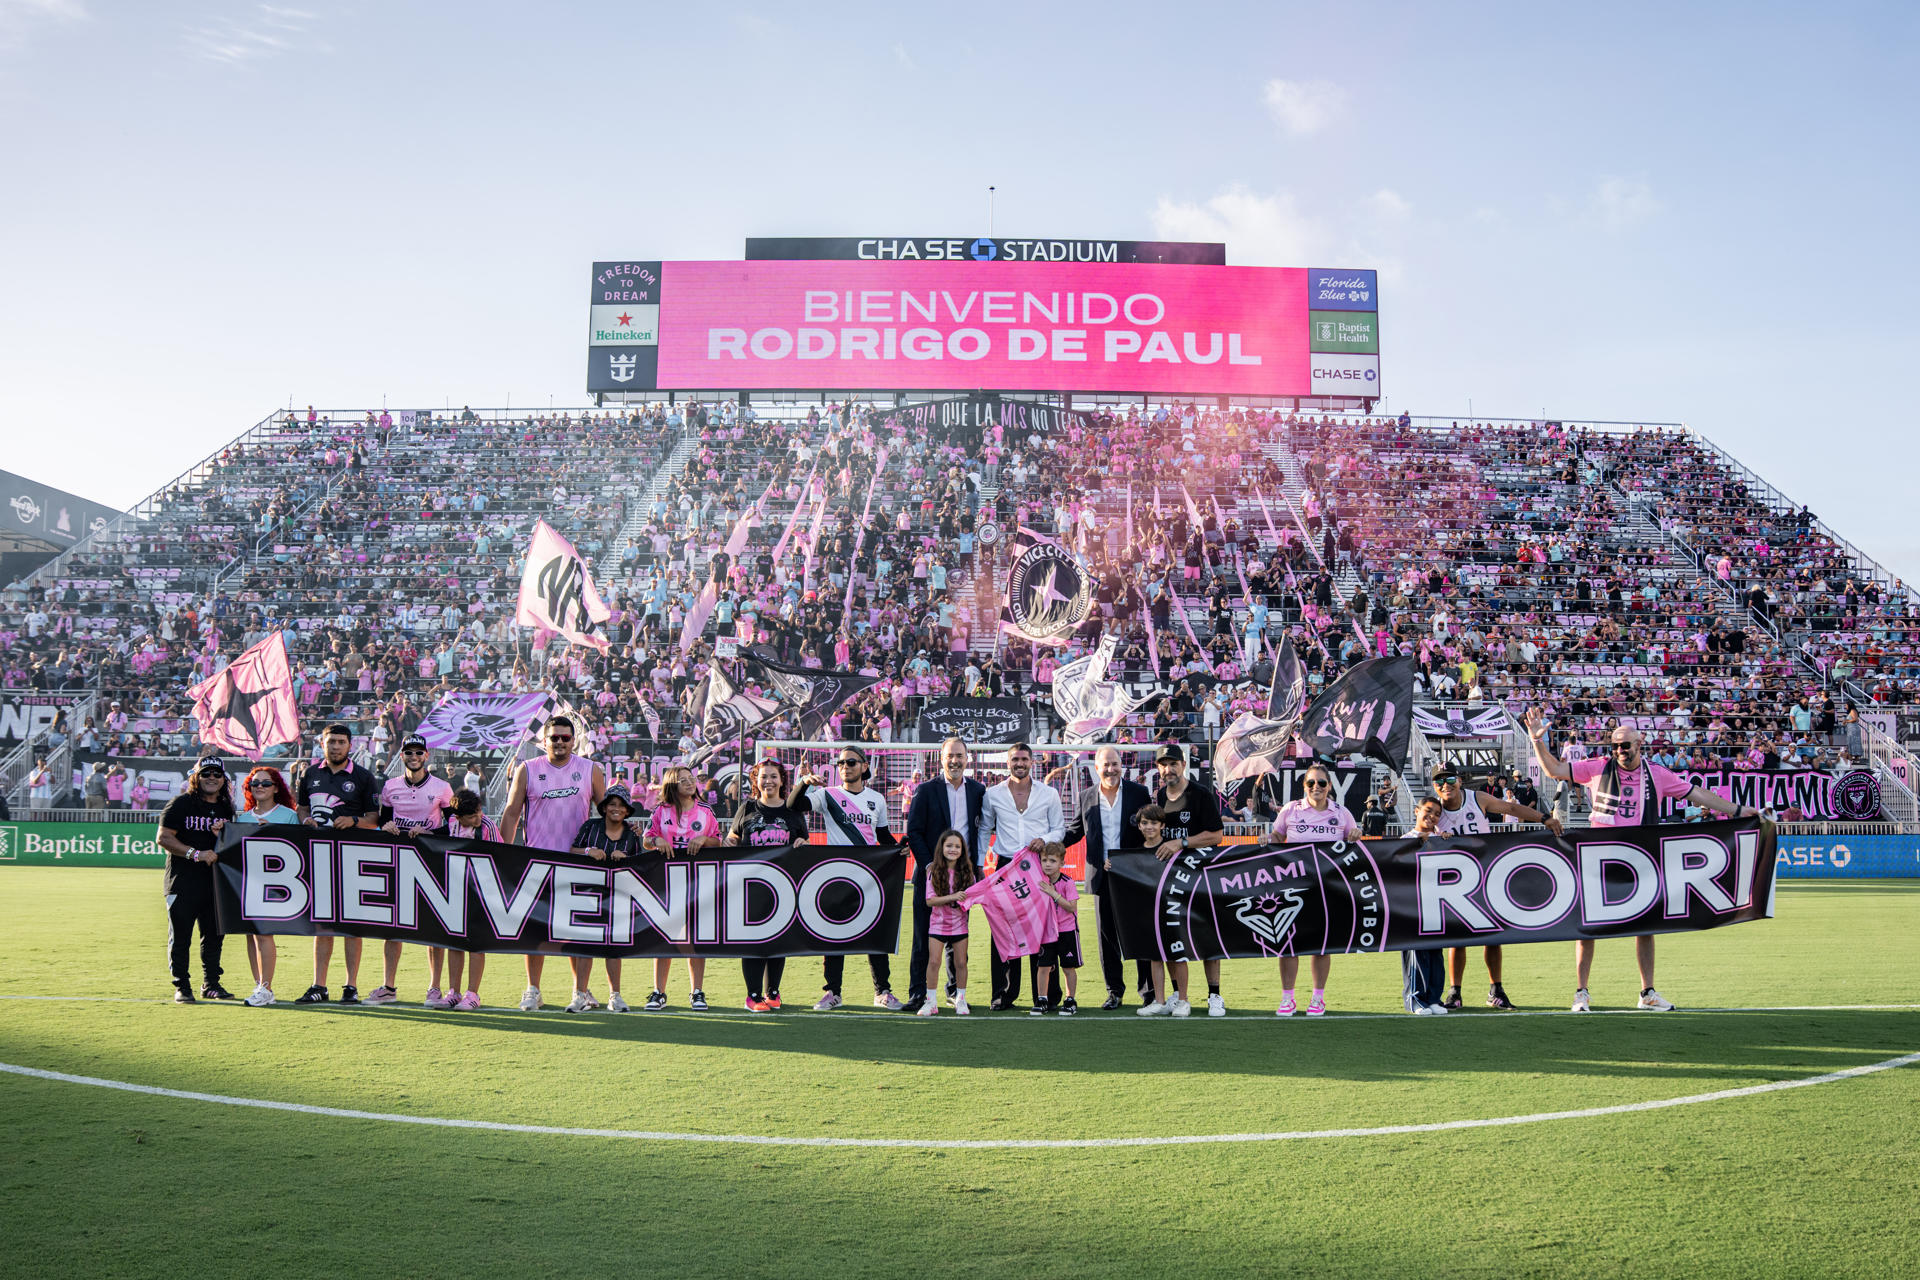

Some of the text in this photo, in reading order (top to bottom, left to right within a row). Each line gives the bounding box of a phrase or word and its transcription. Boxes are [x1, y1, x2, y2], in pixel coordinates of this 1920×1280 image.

[857, 240, 1118, 263] CHASE STADIUM
[598, 263, 656, 286] FREEDOM
[620, 279, 634, 288] TO
[1318, 276, 1367, 289] Florida
[604, 291, 648, 301] DREAM
[1318, 289, 1346, 301] Blue
[804, 290, 1165, 326] BIENVENIDO
[595, 330, 652, 341] Heineken
[1338, 322, 1370, 334] Baptist
[1338, 332, 1369, 343] Health
[707, 327, 1262, 365] RODRIGO DE PAUL
[1312, 368, 1361, 380] CHASE
[975, 403, 993, 427] LA
[1031, 408, 1048, 431] NO
[1476, 719, 1506, 730] MIAMI
[1893, 766, 1906, 778] 110
[1729, 772, 1838, 819] MIAMI
[24, 833, 168, 859] Baptist Heal
[1776, 847, 1825, 866] ASE
[1219, 859, 1308, 894] MIAMI
[1415, 829, 1761, 936] RODRI
[241, 836, 886, 945] BIENVENIDO
[1331, 840, 1359, 867] DE
[1353, 871, 1379, 954] FÚTBO
